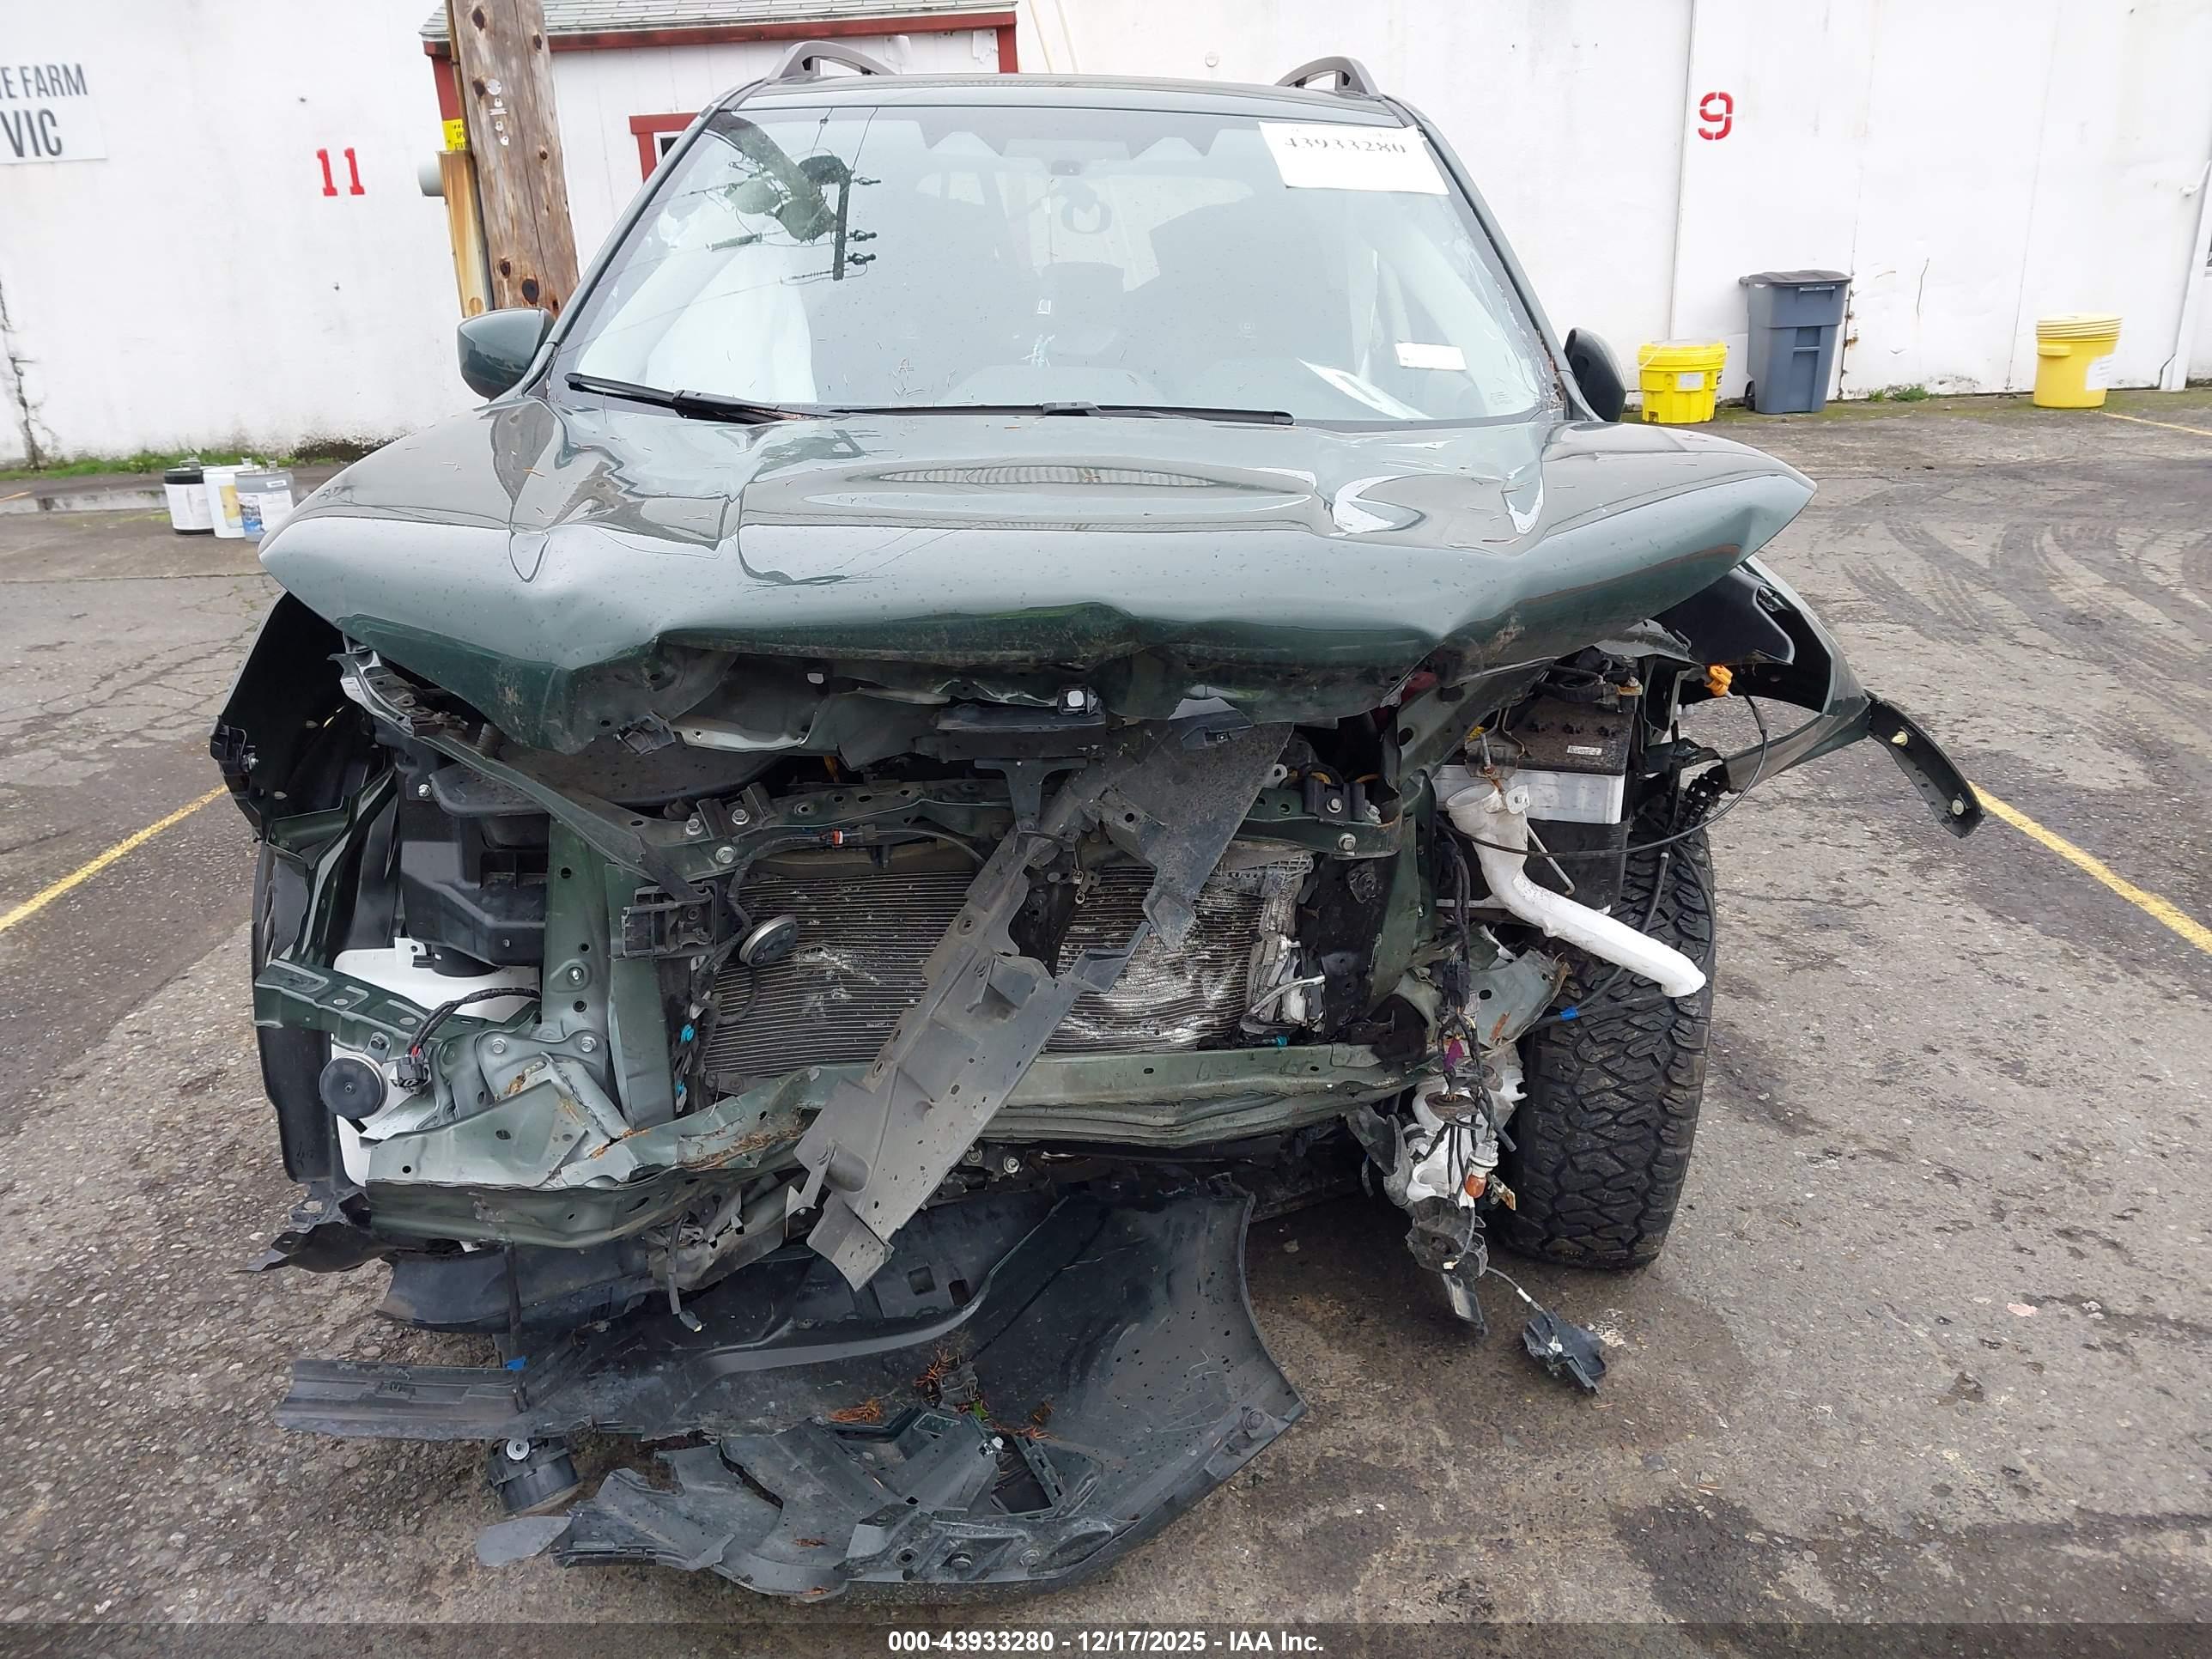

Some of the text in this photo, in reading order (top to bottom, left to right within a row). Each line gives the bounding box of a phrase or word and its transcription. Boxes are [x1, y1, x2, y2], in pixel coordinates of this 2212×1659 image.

[0, 63, 88, 99] E FARM
[0, 108, 63, 157] VIC
[1698, 91, 1733, 140] 9
[316, 148, 365, 196] 11
